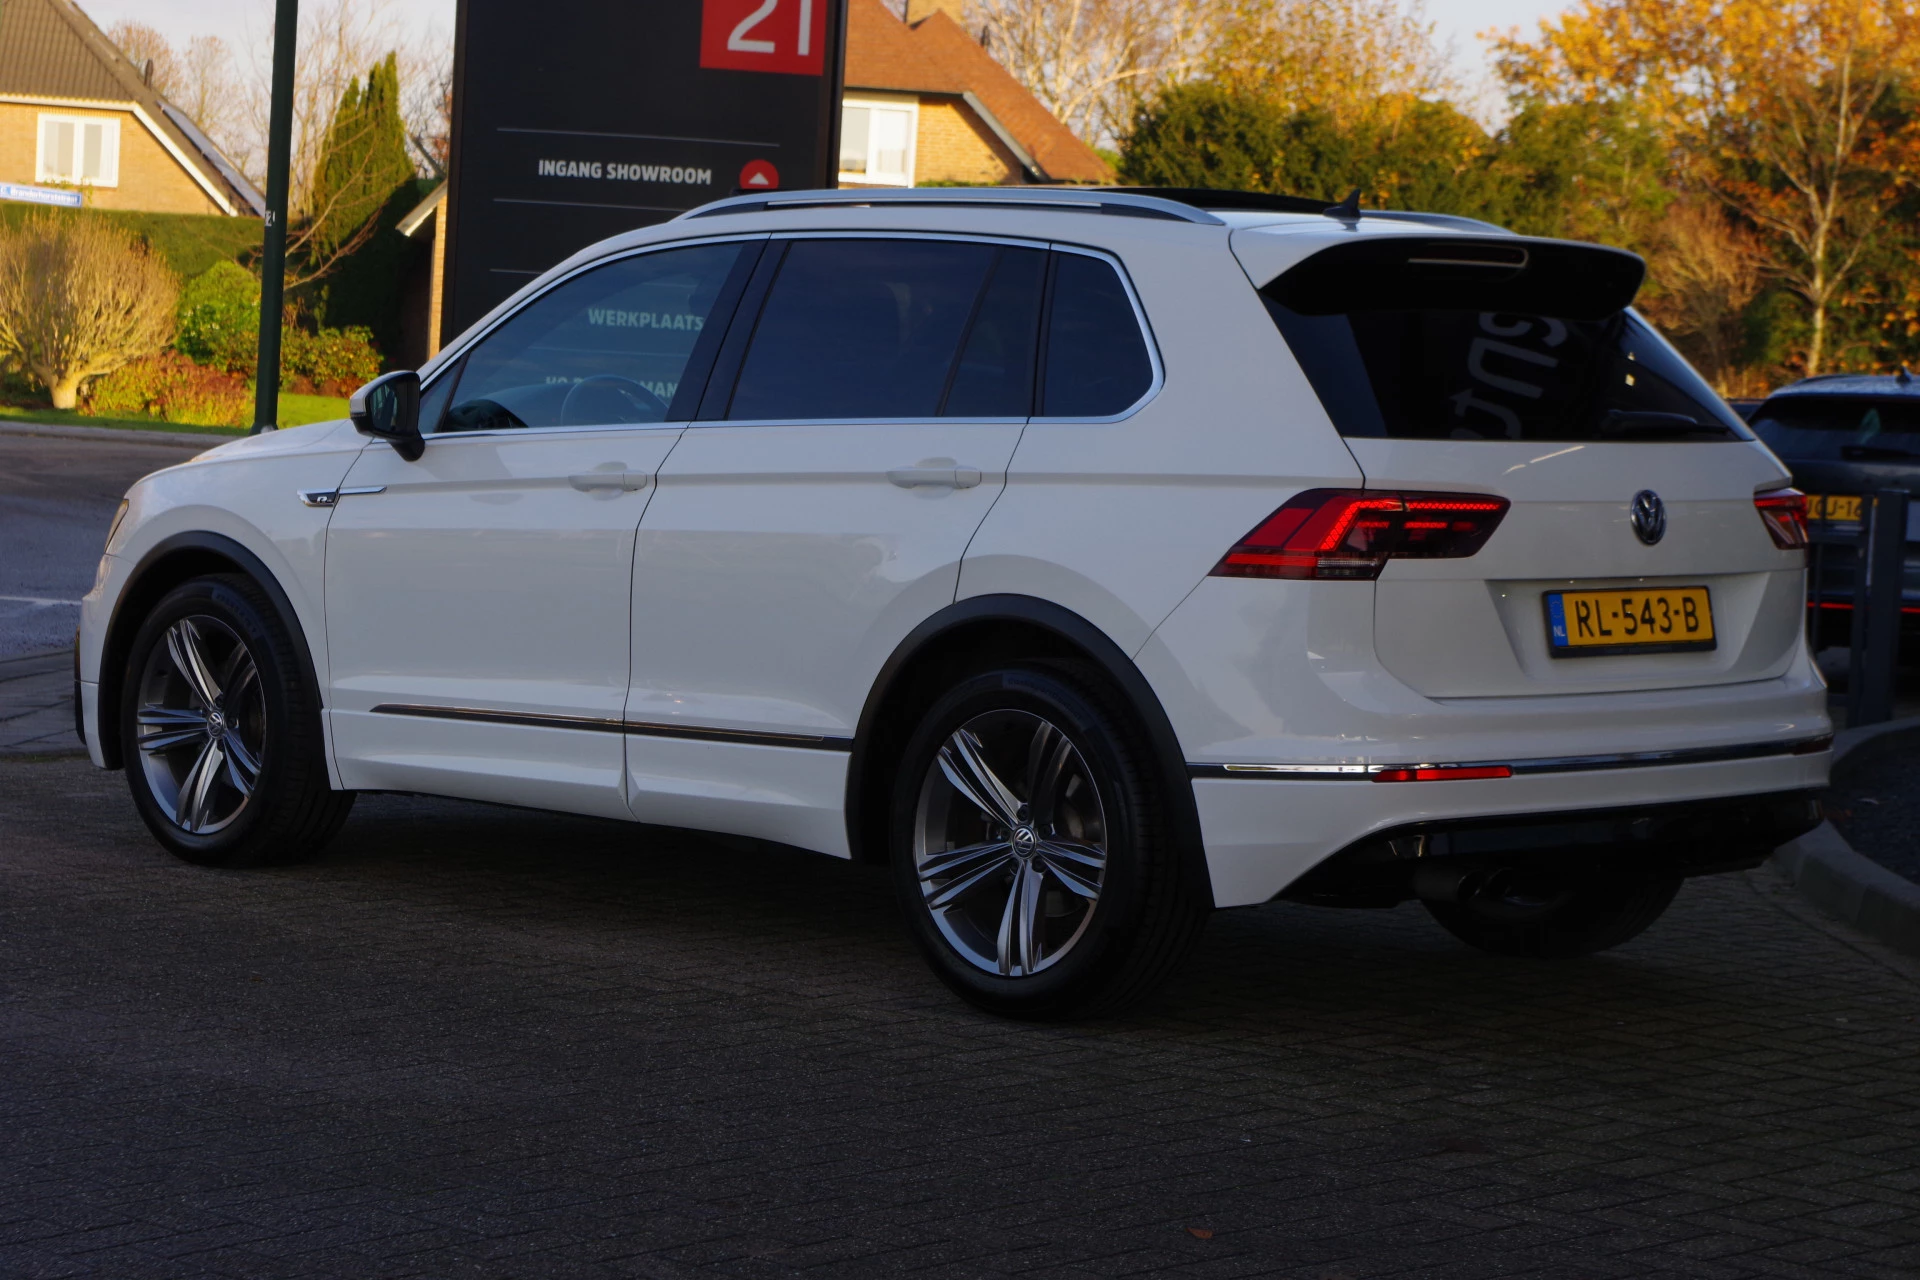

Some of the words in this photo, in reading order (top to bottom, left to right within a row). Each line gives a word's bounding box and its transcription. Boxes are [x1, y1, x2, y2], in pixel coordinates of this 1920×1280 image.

[727, 0, 812, 56] 21
[538, 159, 602, 179] INGANG
[606, 163, 712, 185] SHOWROOM
[588, 308, 704, 331] WERKPLAATS
[1575, 596, 1699, 638] RL-543-B
[1553, 625, 1566, 637] NL
